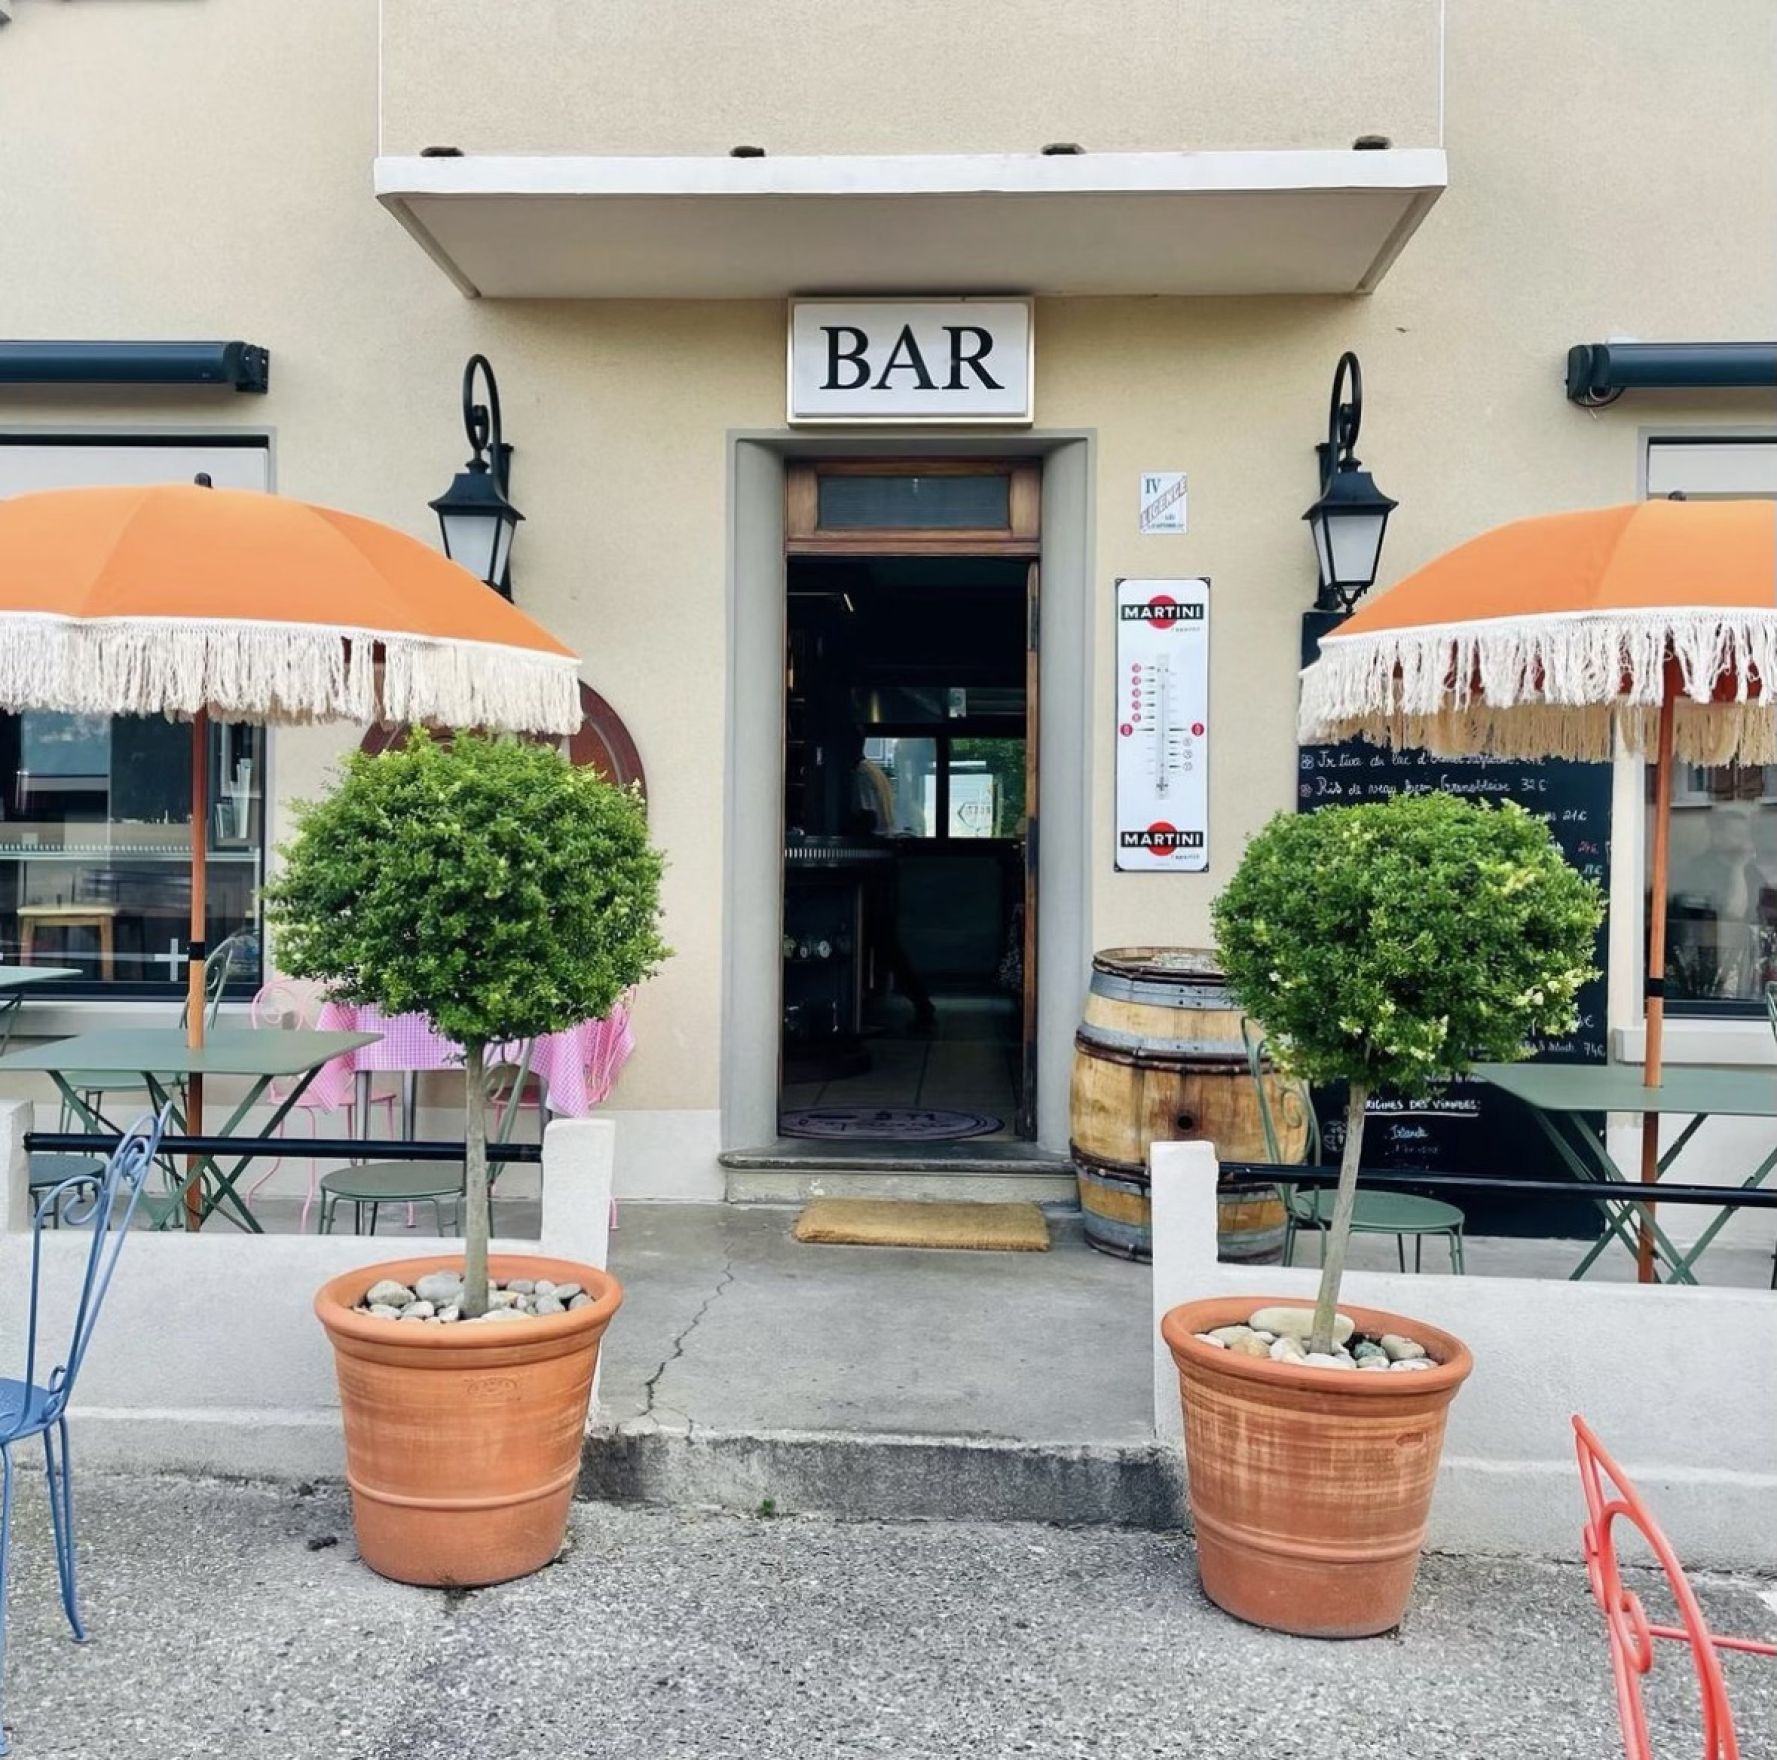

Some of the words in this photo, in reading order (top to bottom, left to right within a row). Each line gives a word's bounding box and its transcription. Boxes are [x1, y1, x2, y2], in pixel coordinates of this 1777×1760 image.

[820, 324, 1005, 389] BAR
[1146, 478, 1162, 494] IV
[1124, 604, 1202, 620] MARTINI
[1124, 833, 1201, 846] MARTINI
